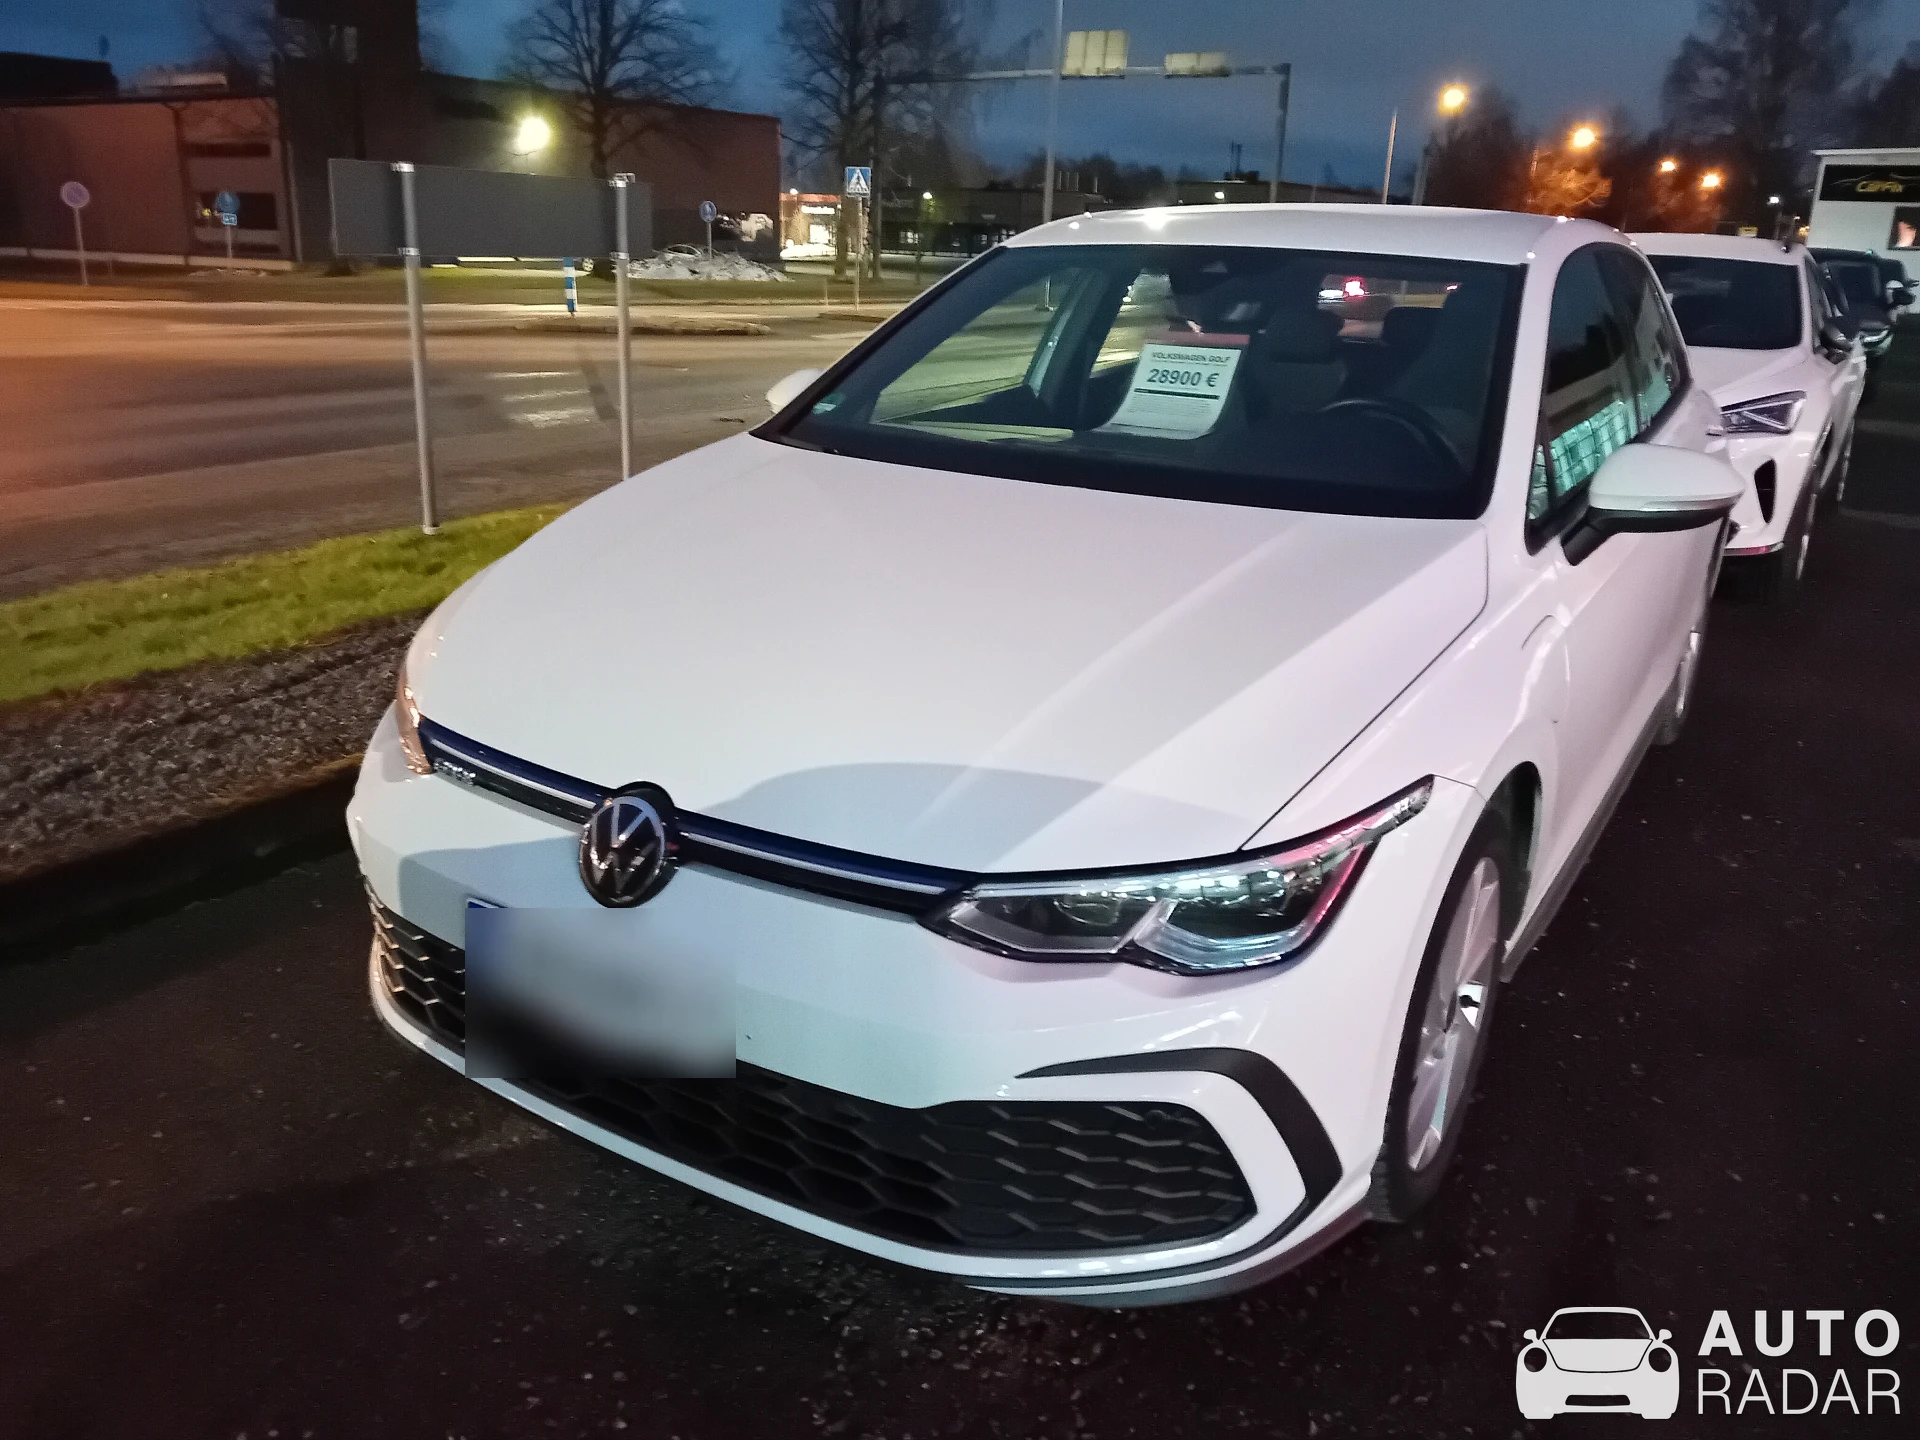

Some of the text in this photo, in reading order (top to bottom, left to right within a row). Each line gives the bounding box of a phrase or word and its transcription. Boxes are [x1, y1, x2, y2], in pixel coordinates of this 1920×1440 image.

[1152, 352, 1231, 363] VOLKSWAGEN GOLF
[1147, 368, 1219, 387] 28900 €
